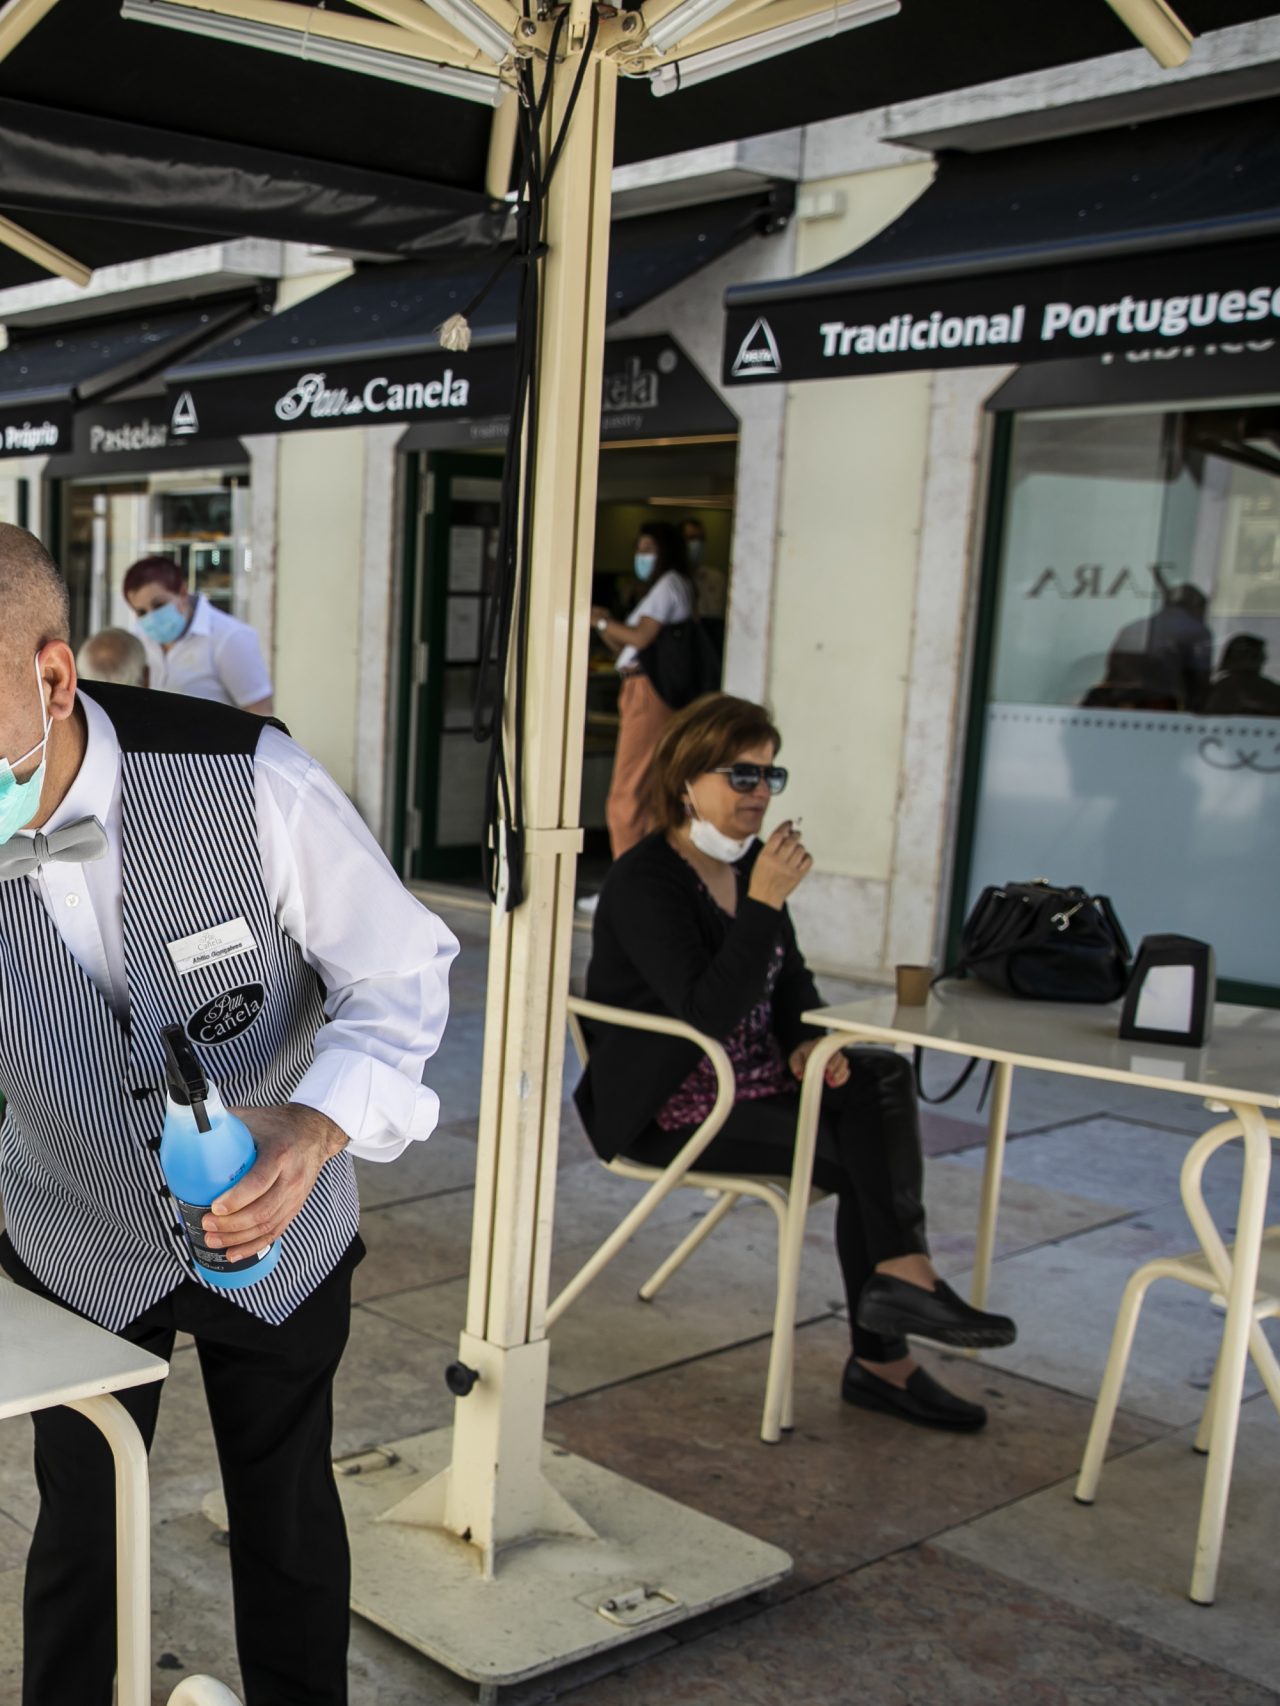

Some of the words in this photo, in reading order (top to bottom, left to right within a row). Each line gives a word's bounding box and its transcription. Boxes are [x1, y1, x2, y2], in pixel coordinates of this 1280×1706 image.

[820, 304, 1025, 356] Tradicional
[363, 368, 470, 412] Canela
[5, 421, 59, 450] Próprio
[200, 1000, 260, 1042] Canela
